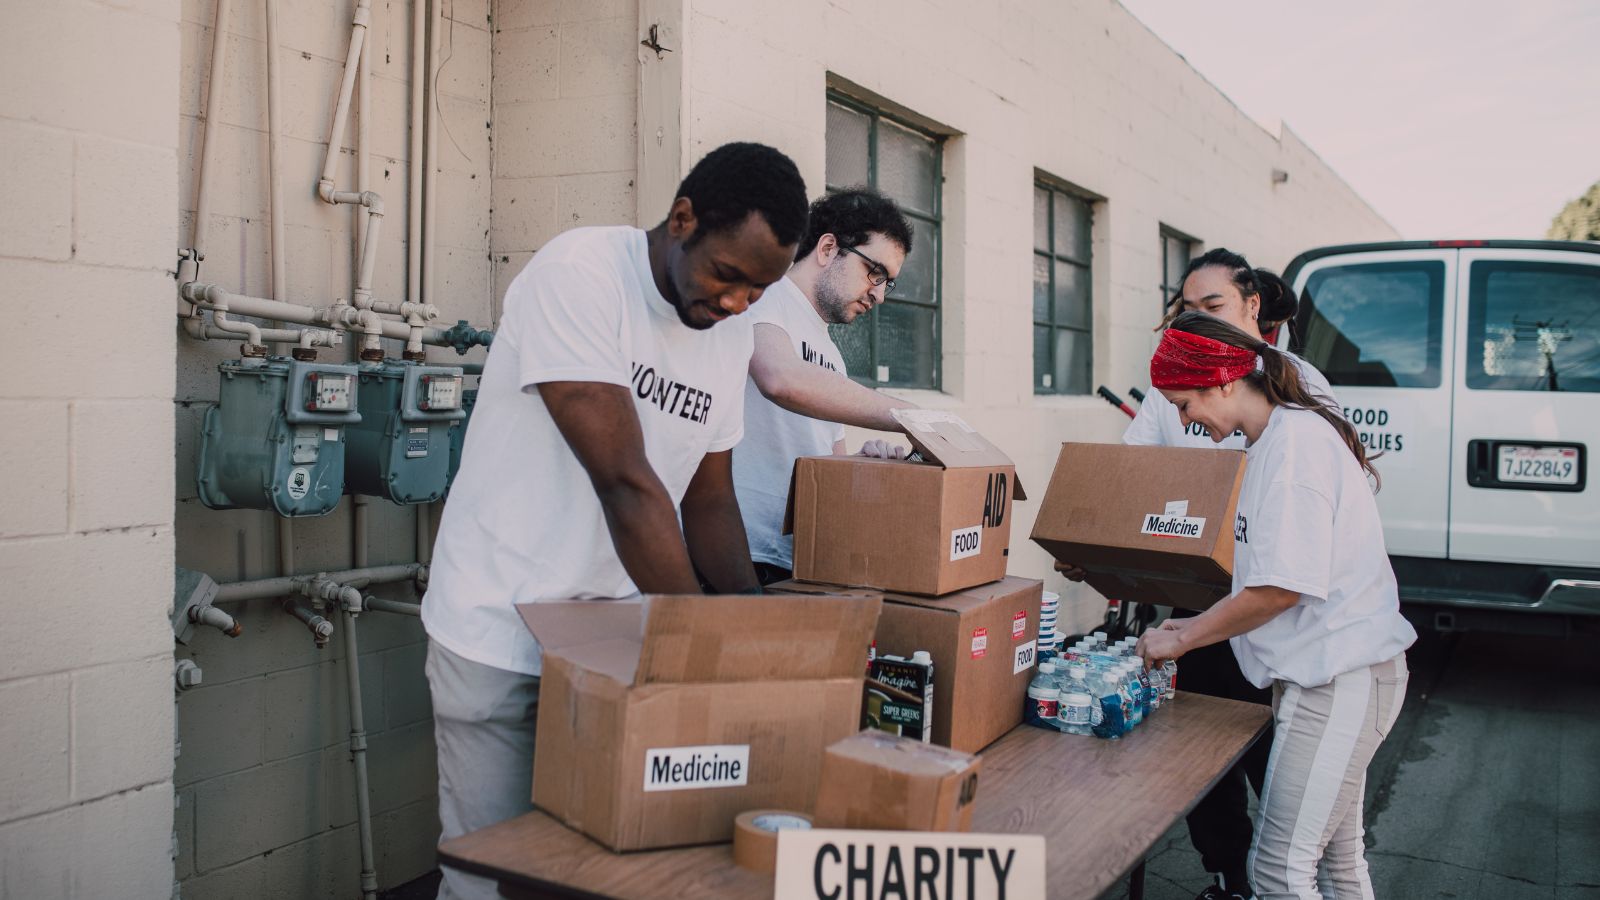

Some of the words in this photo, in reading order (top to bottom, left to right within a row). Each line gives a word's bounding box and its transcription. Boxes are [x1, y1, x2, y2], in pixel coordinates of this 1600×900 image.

[631, 361, 712, 425] VOLNTEER
[1343, 407, 1388, 426] FOOD
[1360, 432, 1404, 451] PLIES
[1504, 458, 1572, 478] 7J22849
[982, 473, 1007, 528] AID
[1146, 516, 1199, 535] Medicine
[954, 531, 979, 554] FOOD
[1017, 647, 1033, 667] FOOD
[883, 705, 900, 716] SUPER
[901, 708, 920, 720] GREENS
[651, 754, 741, 784] Medicine
[813, 843, 1016, 900] CHARITY
